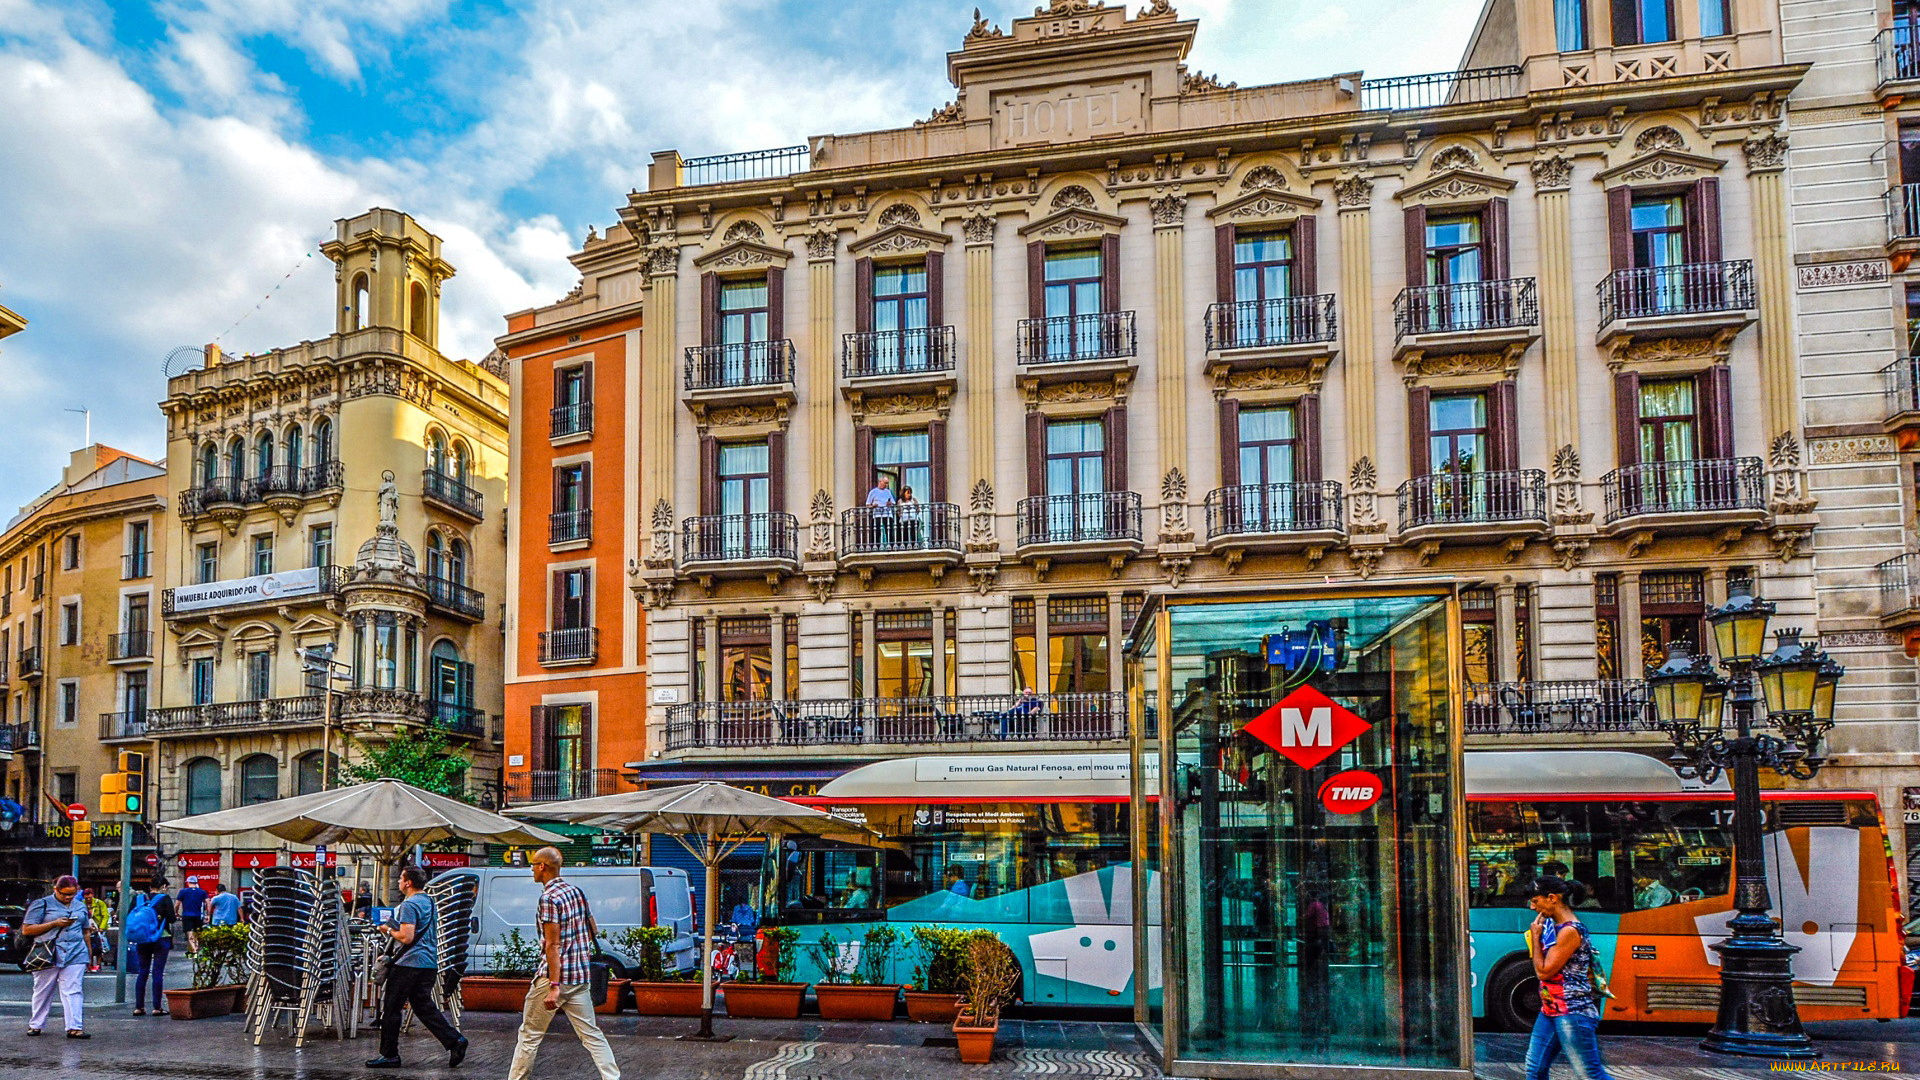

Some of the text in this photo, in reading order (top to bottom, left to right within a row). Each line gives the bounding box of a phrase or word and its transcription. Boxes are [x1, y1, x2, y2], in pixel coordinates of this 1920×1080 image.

[1035, 15, 1105, 39] 1894
[1007, 91, 1131, 138] HOTEL
[176, 585, 258, 604] INMUEBLE ADQUIRIDO POR
[1281, 707, 1332, 747] M
[1006, 764, 1039, 772] Natural
[1041, 764, 1075, 772] Fenosa,
[1331, 787, 1374, 800] TMB
[188, 858, 220, 867] Santander
[432, 858, 465, 867] Santander
